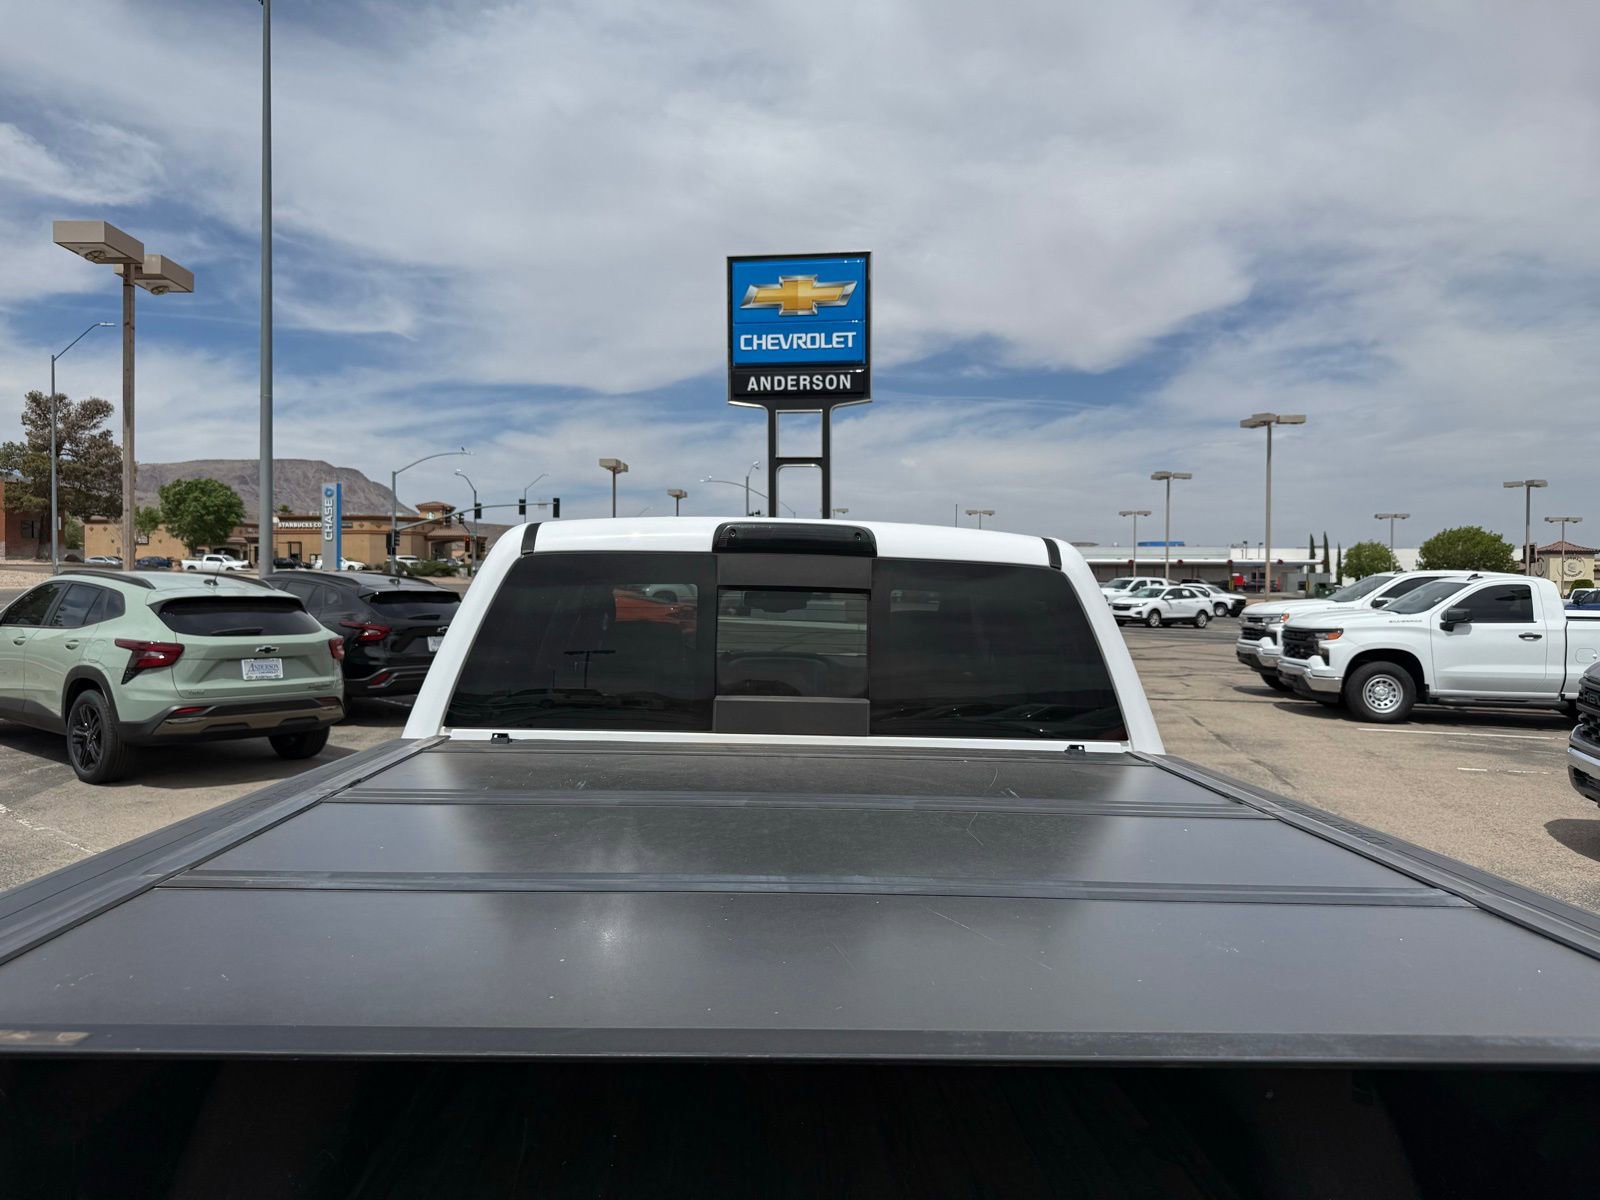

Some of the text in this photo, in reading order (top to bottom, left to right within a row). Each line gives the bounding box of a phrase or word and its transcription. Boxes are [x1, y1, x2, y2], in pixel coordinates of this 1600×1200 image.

[739, 331, 857, 351] CHEVROLET
[747, 374, 852, 392] ANDERSON
[324, 498, 333, 541] CHASE
